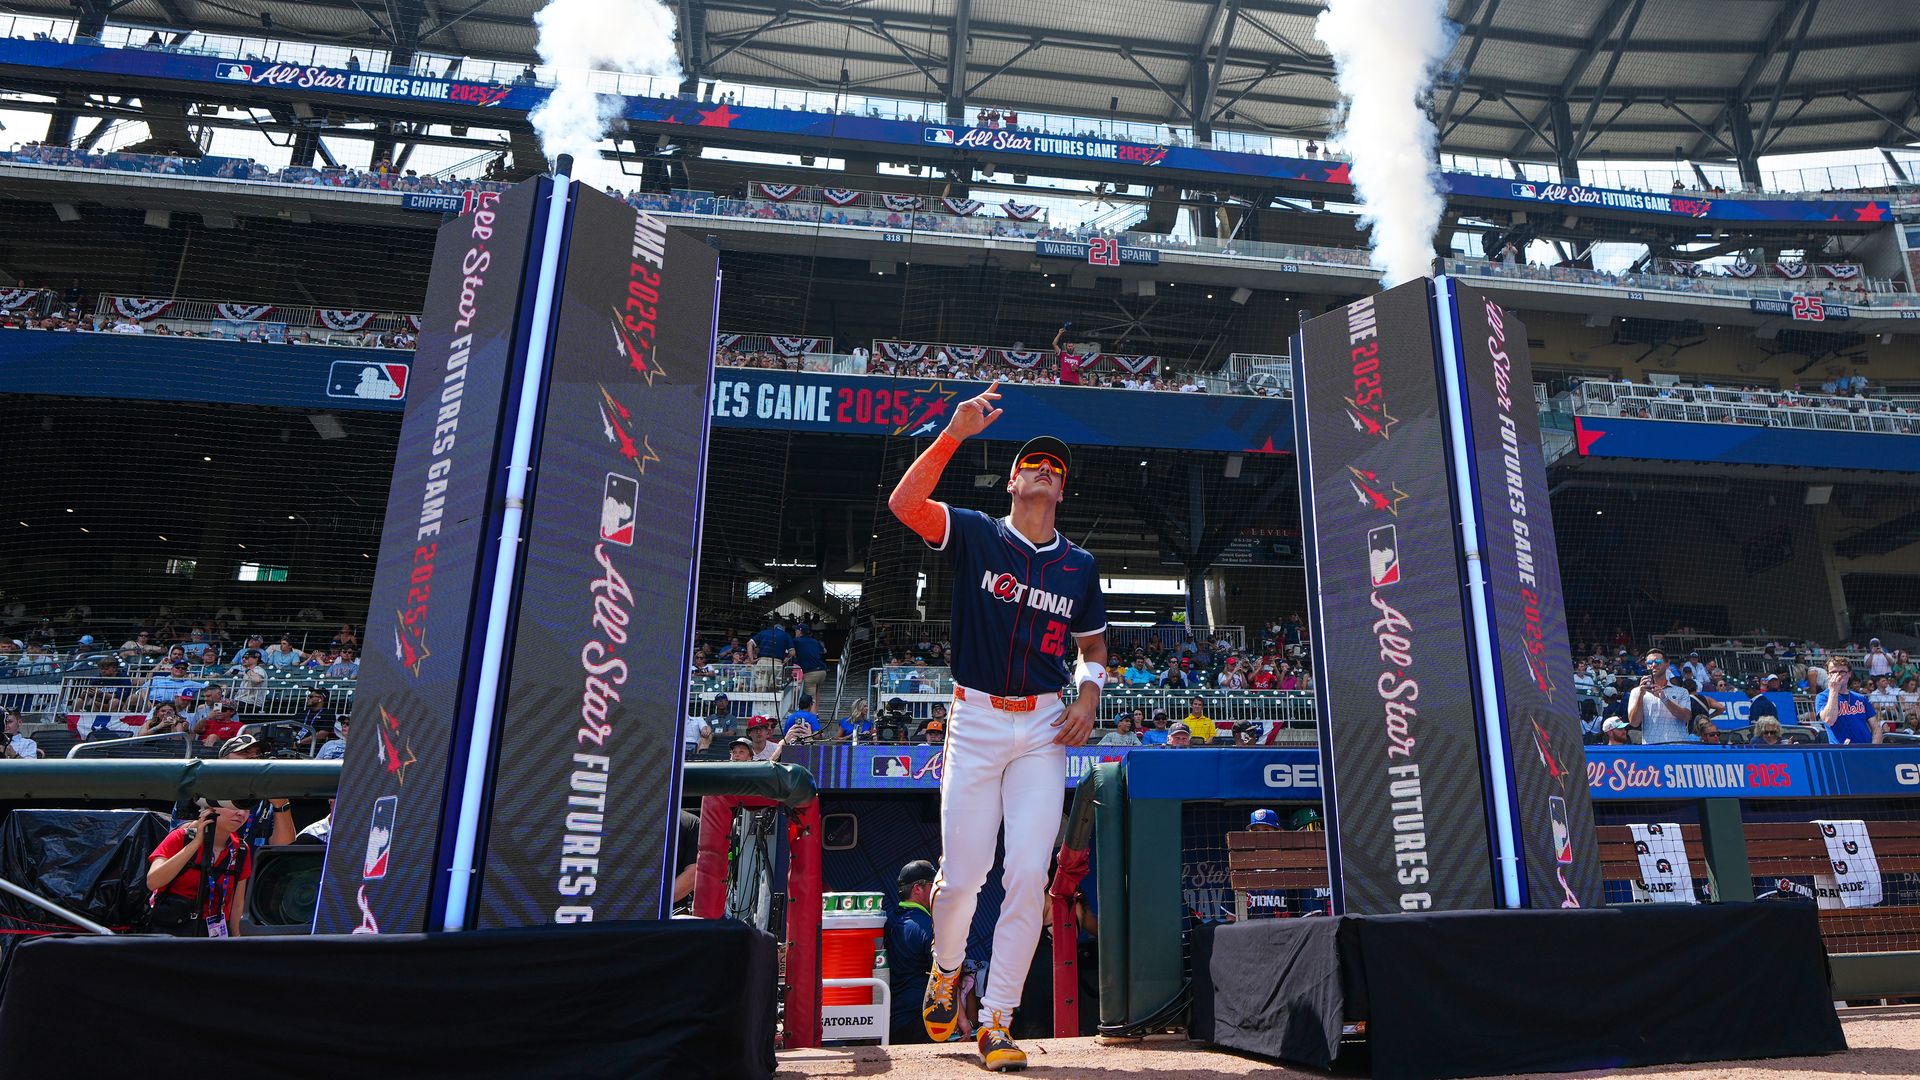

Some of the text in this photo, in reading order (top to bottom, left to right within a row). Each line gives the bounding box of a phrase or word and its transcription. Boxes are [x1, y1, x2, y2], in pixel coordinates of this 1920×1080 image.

[252, 64, 487, 102] All Star FUTURES GAME 2025
[955, 128, 1149, 162] All Star FUTURES GAME 2025
[410, 196, 457, 210] CHIPPER
[1538, 184, 1698, 214] All Star FUTURES GAME 2025
[886, 234, 901, 242] 318
[1044, 237, 1152, 266] WARREN 21 SPAHN
[624, 262, 661, 339] 2025
[1755, 295, 1849, 322] ANDRUW 25 JONES
[756, 383, 832, 422] GAME
[837, 387, 909, 425] 2025
[1352, 342, 1382, 406] 2025
[1488, 336, 1512, 413] Star
[404, 195, 500, 626] ll Star FUTURES GAME 2025
[1499, 413, 1527, 517] FUTURES
[1512, 518, 1536, 588] GAME
[590, 543, 636, 644] All
[1521, 589, 1546, 656] 2025
[1370, 590, 1413, 668] All
[578, 640, 628, 746] Star
[1377, 671, 1419, 760] Star
[1608, 759, 1662, 791] Star
[1664, 764, 1745, 789] SATURDAY
[1747, 763, 1791, 788] 2025
[1895, 763, 1920, 785] G
[558, 753, 610, 896] FUTURES
[1388, 764, 1430, 885] FUTURES
